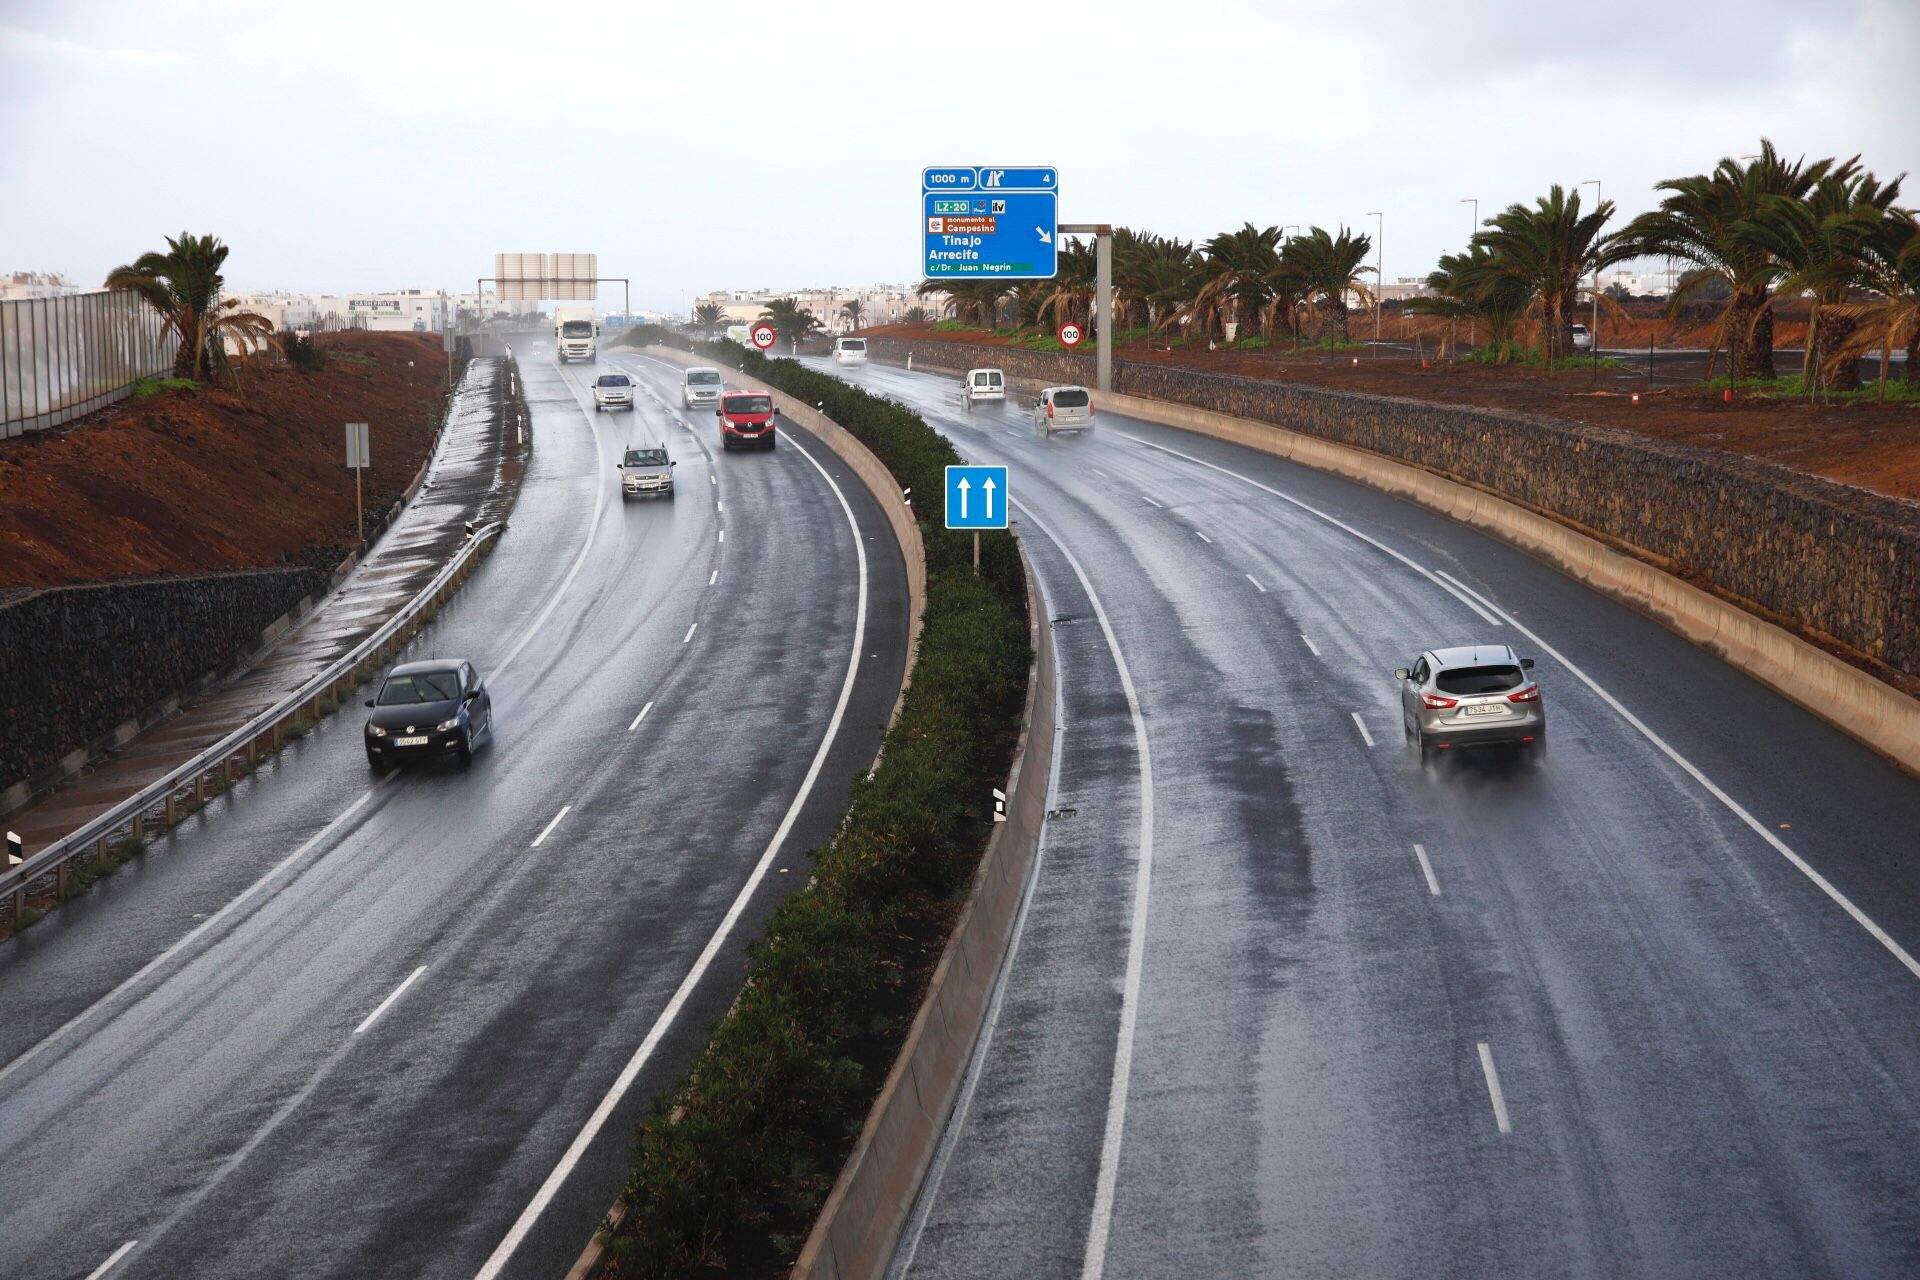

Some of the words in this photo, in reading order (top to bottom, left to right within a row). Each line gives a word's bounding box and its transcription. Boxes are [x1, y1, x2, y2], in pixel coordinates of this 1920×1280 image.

[930, 174, 956, 183] 1000
[1042, 174, 1050, 183] 4
[947, 225, 995, 233] Campesino
[942, 235, 982, 247] Tinajo
[929, 249, 979, 260] Arrecife
[958, 263, 978, 271] Juan
[756, 333, 772, 341] 100
[1063, 330, 1078, 339] 100
